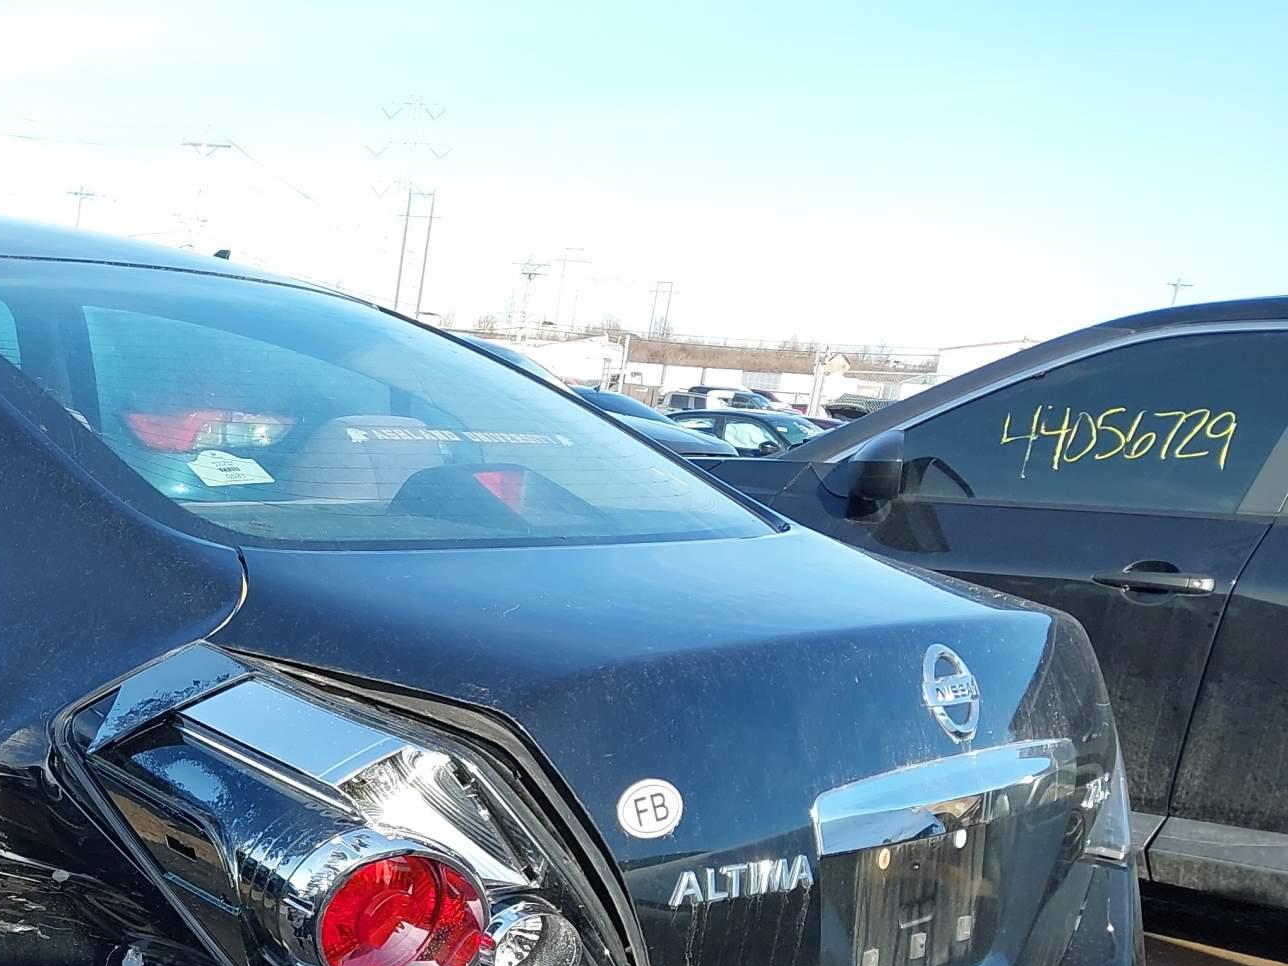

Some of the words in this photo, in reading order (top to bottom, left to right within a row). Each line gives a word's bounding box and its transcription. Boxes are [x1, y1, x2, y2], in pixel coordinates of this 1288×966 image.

[372, 429, 463, 441] ASHLAND
[1001, 405, 1237, 479] 44056729
[935, 680, 980, 702] NISSAN
[634, 793, 670, 828] FB
[669, 855, 814, 910] ALTIMA
